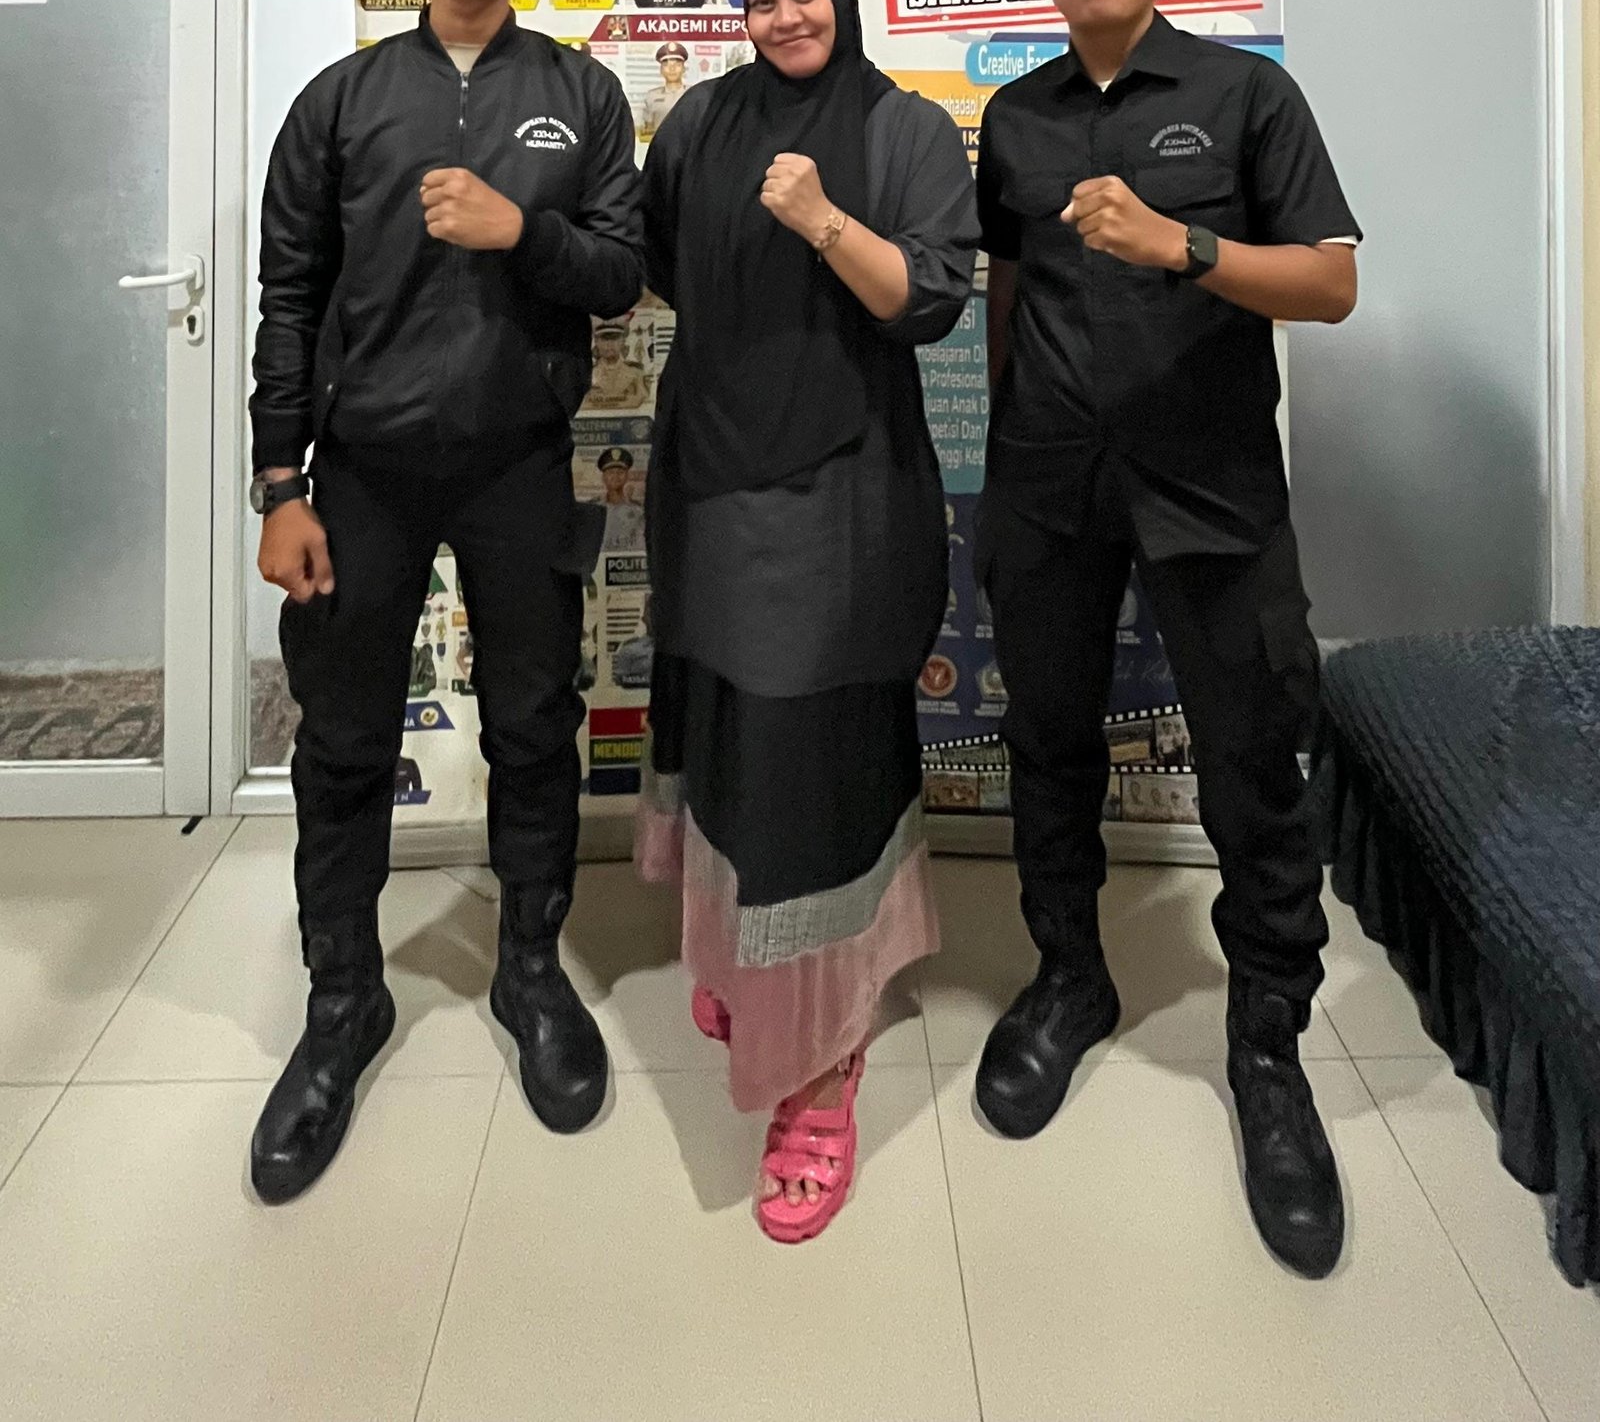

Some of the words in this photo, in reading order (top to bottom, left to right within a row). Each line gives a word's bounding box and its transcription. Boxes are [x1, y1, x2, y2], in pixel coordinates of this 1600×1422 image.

[636, 19, 707, 34] AKADEMI
[978, 44, 1024, 77] Creative
[526, 140, 567, 151] HUMANITY
[1159, 146, 1201, 156] HUMANITY
[952, 397, 978, 414] Anak
[961, 420, 982, 439] Dan
[608, 559, 648, 571] POLITE
